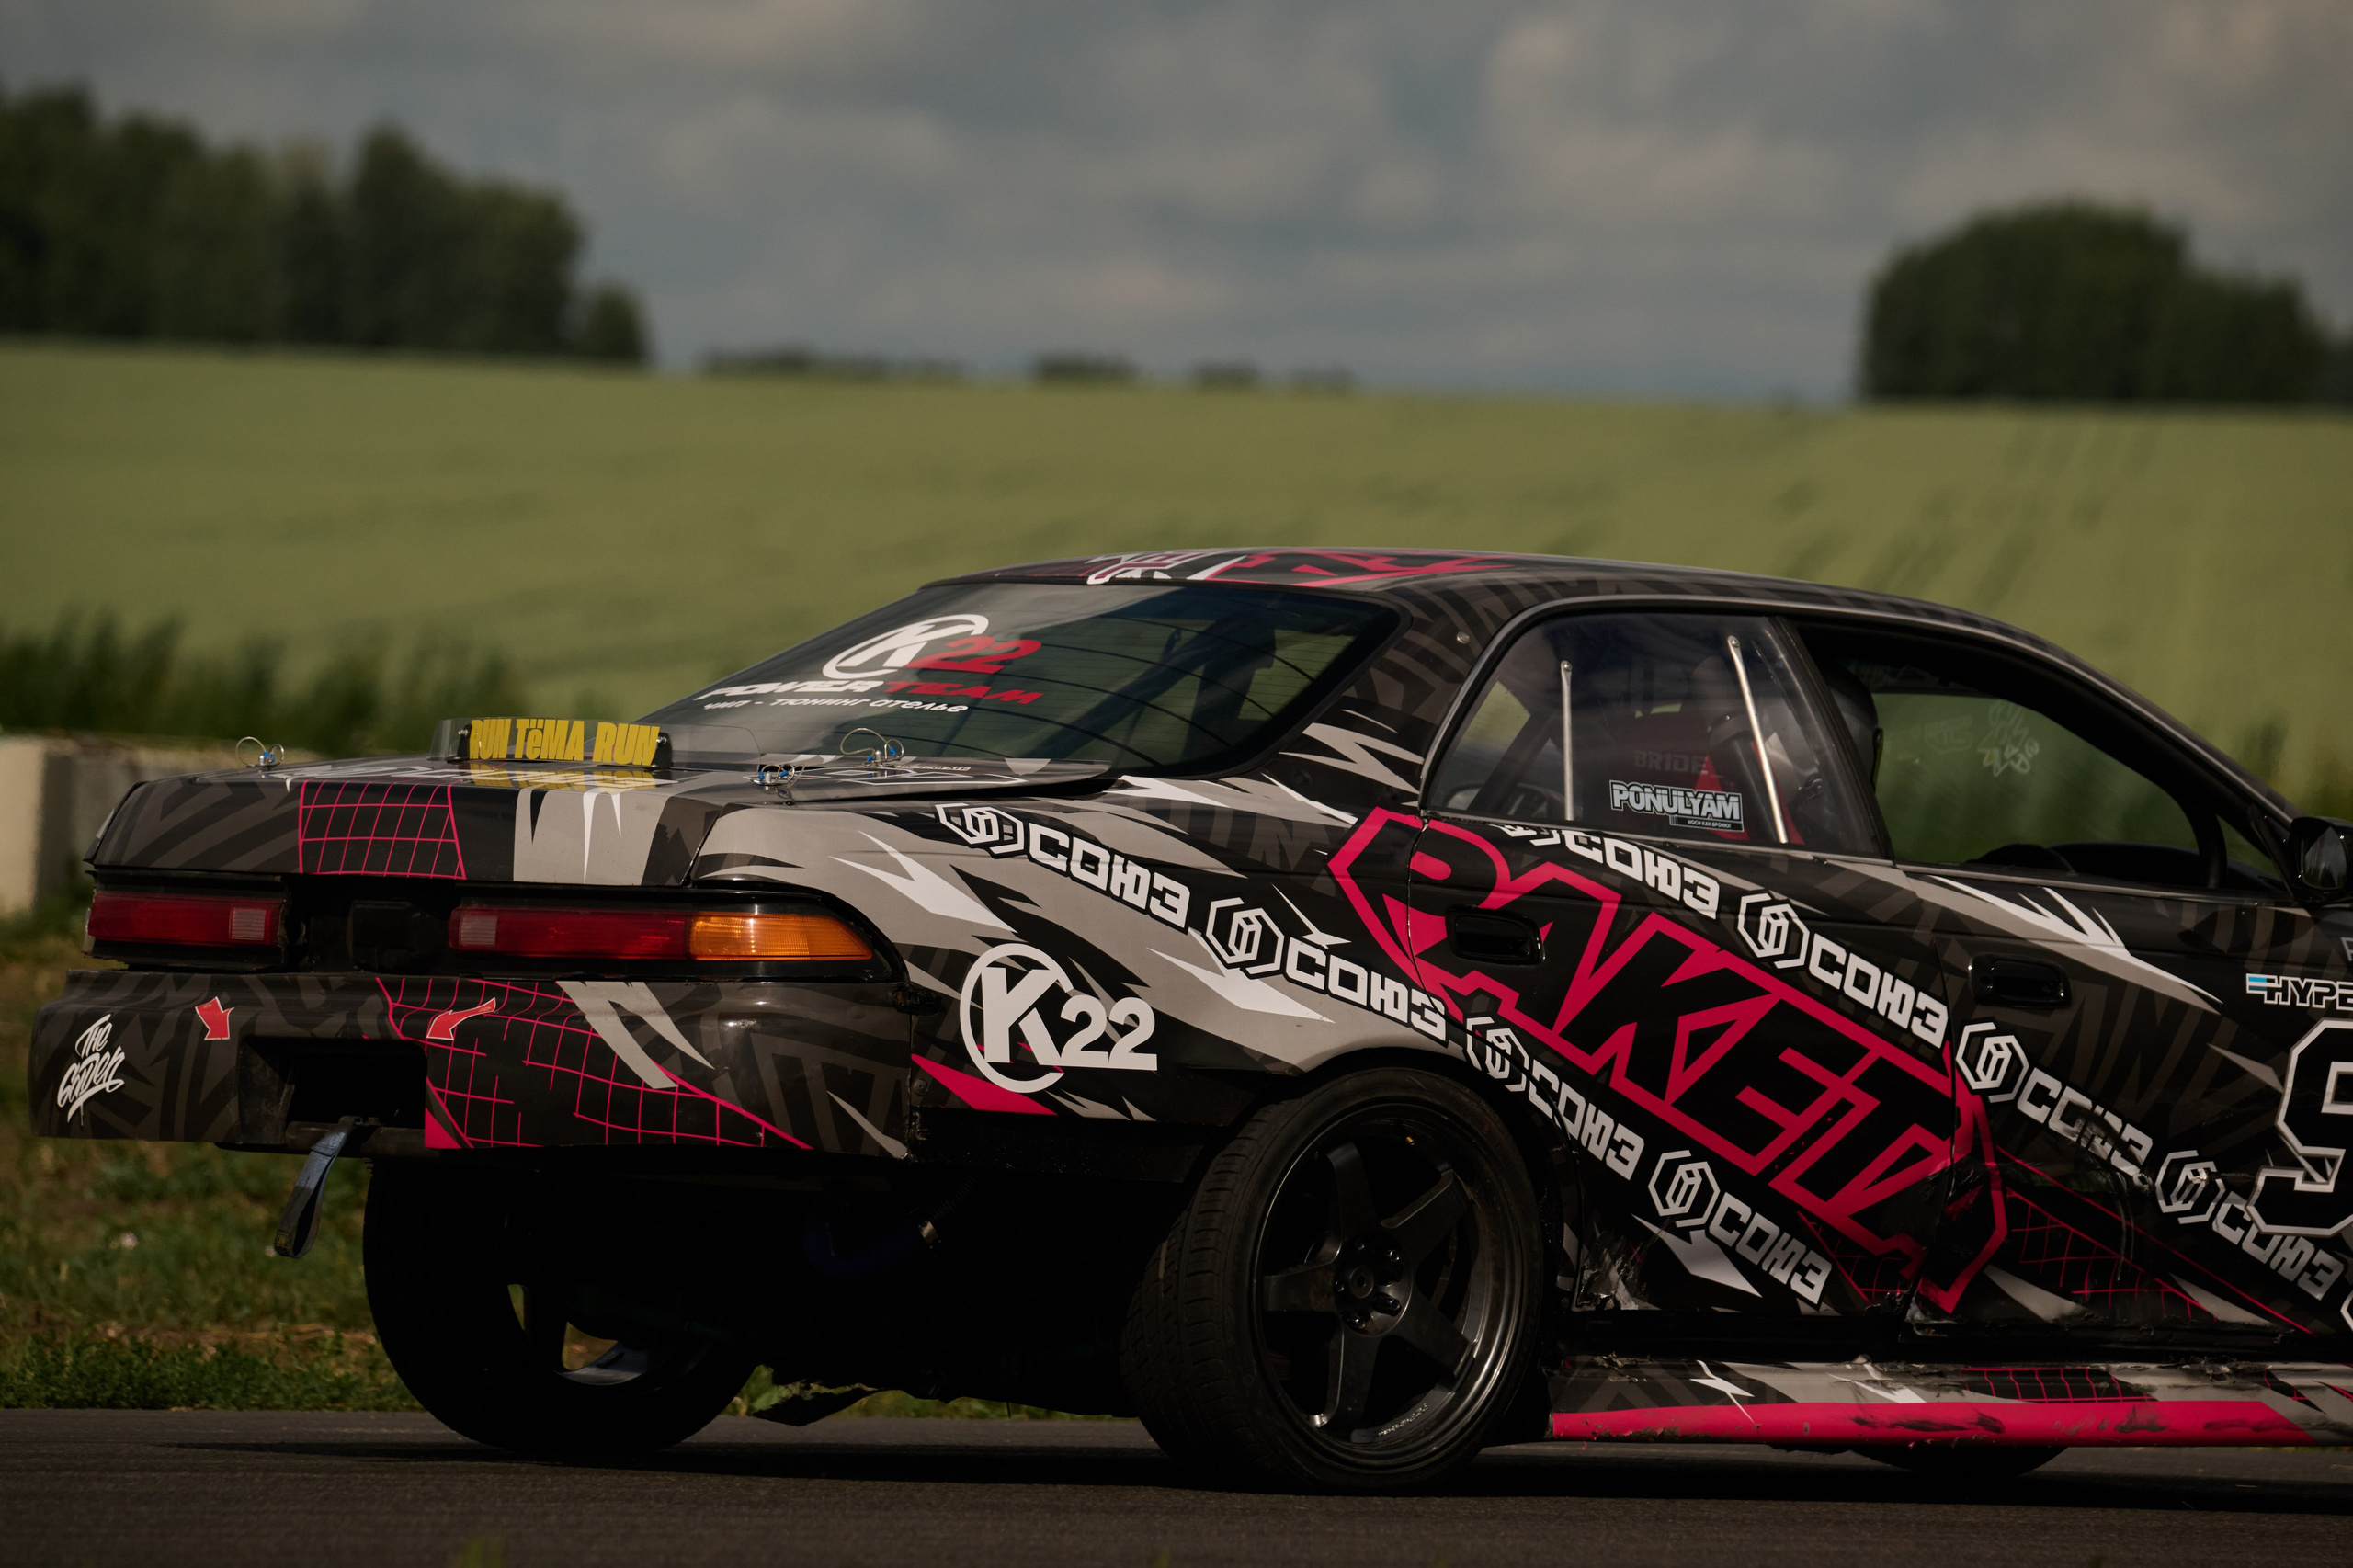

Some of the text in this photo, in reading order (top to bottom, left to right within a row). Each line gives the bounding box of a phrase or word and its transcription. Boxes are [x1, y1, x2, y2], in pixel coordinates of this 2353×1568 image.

[469, 718, 512, 760] RUN
[592, 721, 661, 767] RUN
[1633, 749, 1710, 775] BRIDE
[1610, 781, 1742, 822] PONULYAM
[1029, 823, 1191, 929] СОЮЗ
[1563, 830, 1720, 920] СОЮЗ
[1286, 942, 1446, 1041] СОЮЗ
[1809, 934, 1949, 1049] СОЮЗ
[1528, 1059, 1645, 1181] СОЮЗ
[1712, 1192, 1832, 1305] СОЮЗ
